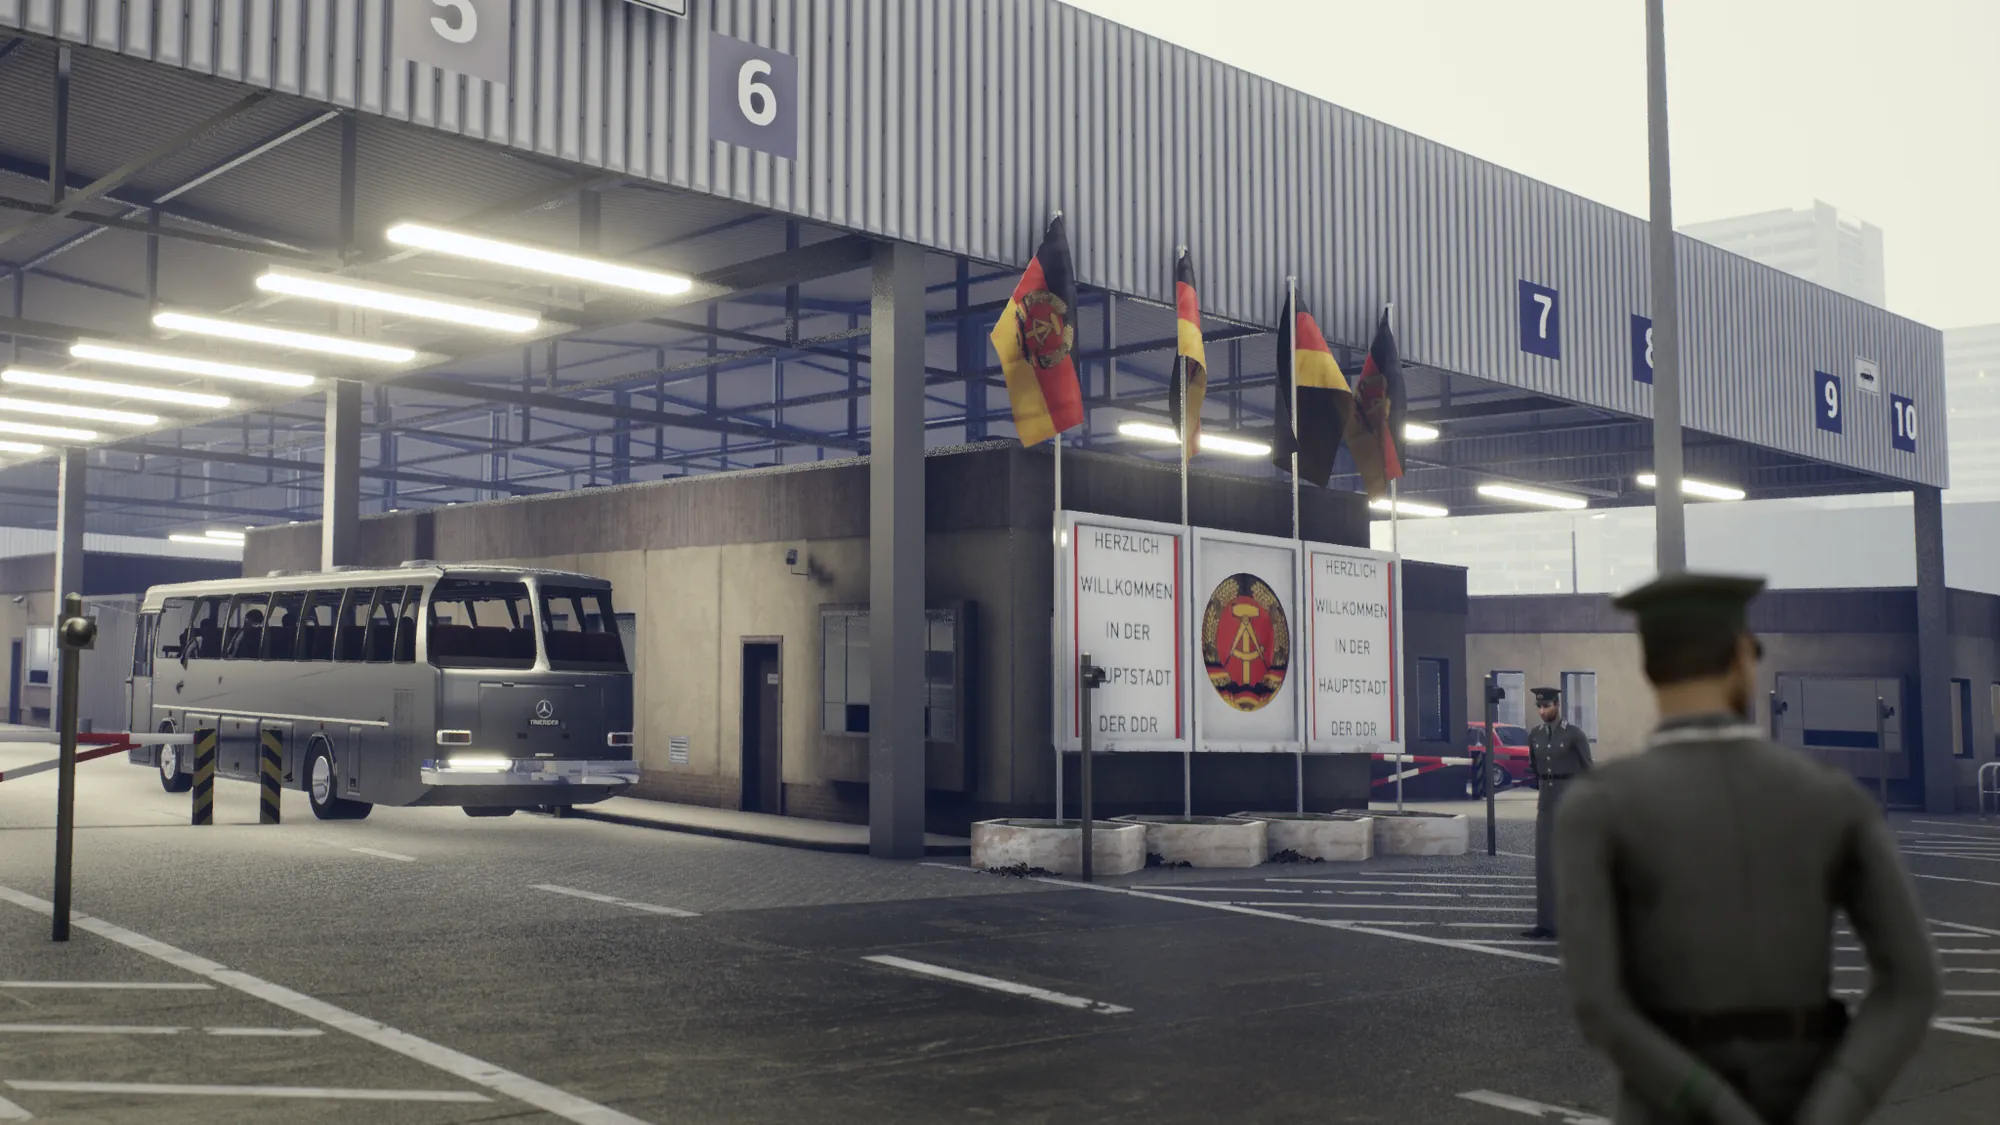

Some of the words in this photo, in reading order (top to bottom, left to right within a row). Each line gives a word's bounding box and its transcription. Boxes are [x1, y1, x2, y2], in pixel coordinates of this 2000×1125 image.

[738, 58, 777, 127] 6
[1533, 292, 1552, 339] 7
[1824, 380, 1838, 419] 9
[1894, 401, 1917, 441] 10
[1094, 531, 1159, 556] HERZLICH
[1326, 559, 1377, 579] HERZLICH
[1080, 575, 1173, 601] WILLKOMMEN
[1314, 597, 1388, 619] WILLKOMMEN
[1105, 621, 1119, 639] IN
[1124, 622, 1151, 641] DER
[1335, 637, 1347, 655] IN
[1349, 639, 1371, 656] DER
[1103, 666, 1172, 687] UPTSTADT
[1318, 677, 1388, 696] HAUPTSTADT
[1099, 714, 1126, 733] DER
[1130, 716, 1159, 734] DDR
[1331, 720, 1353, 737] DER
[1355, 721, 1378, 737] DDR
